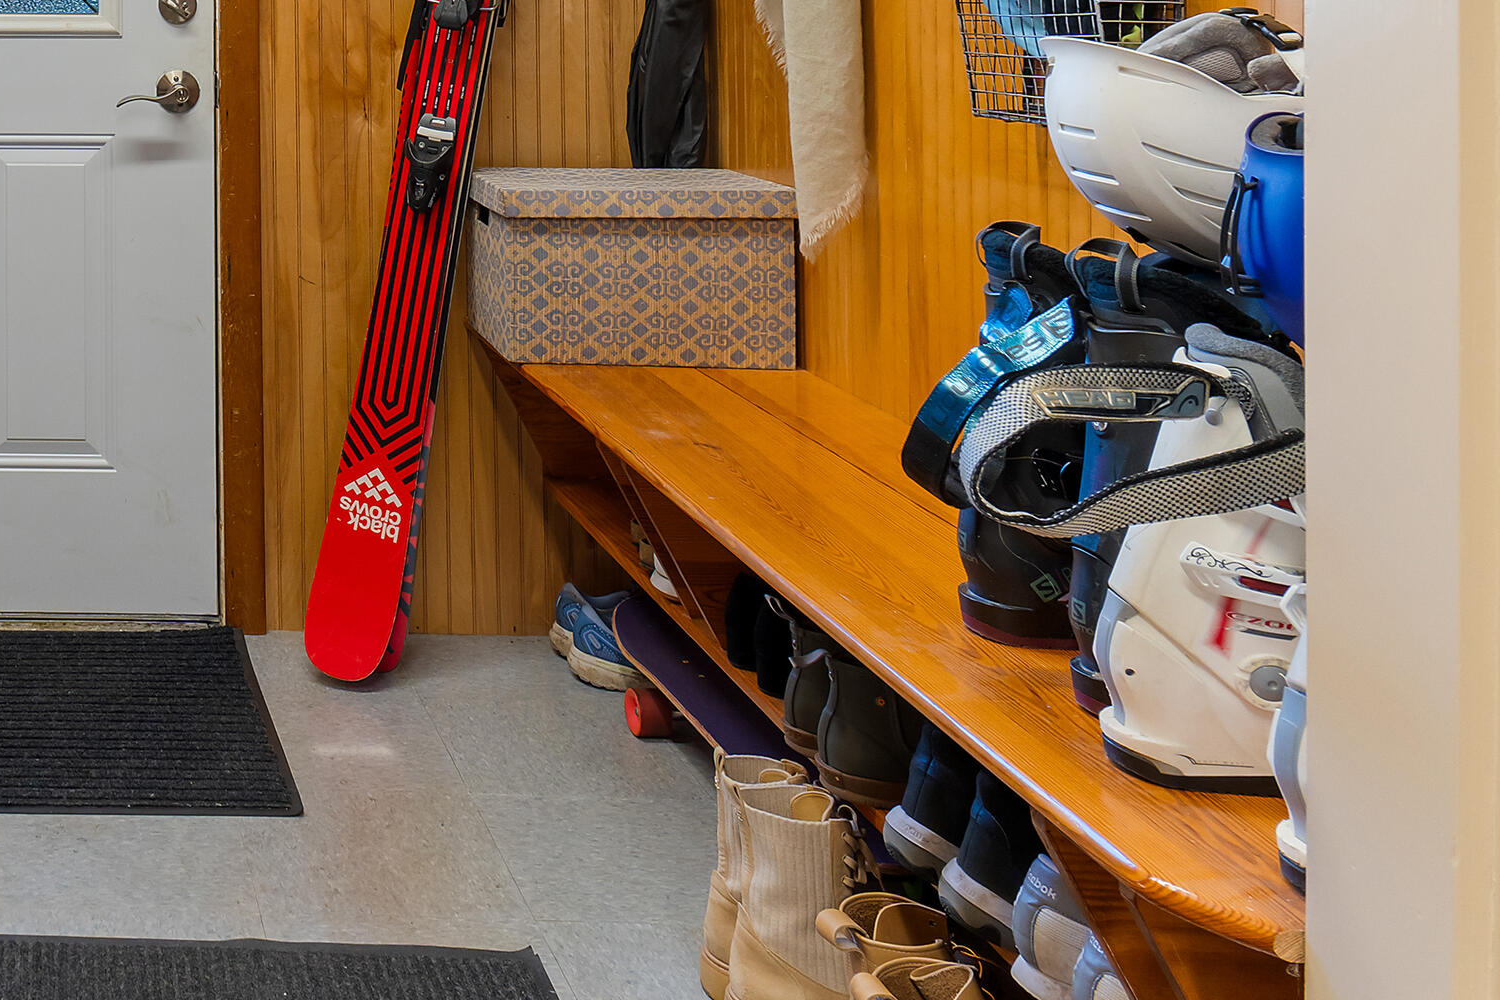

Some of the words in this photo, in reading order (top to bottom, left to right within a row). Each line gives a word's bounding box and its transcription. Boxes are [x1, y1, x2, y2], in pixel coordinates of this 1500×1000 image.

[1036, 391, 1136, 409] HEAD
[339, 495, 401, 525] crows
[347, 512, 400, 544] black
